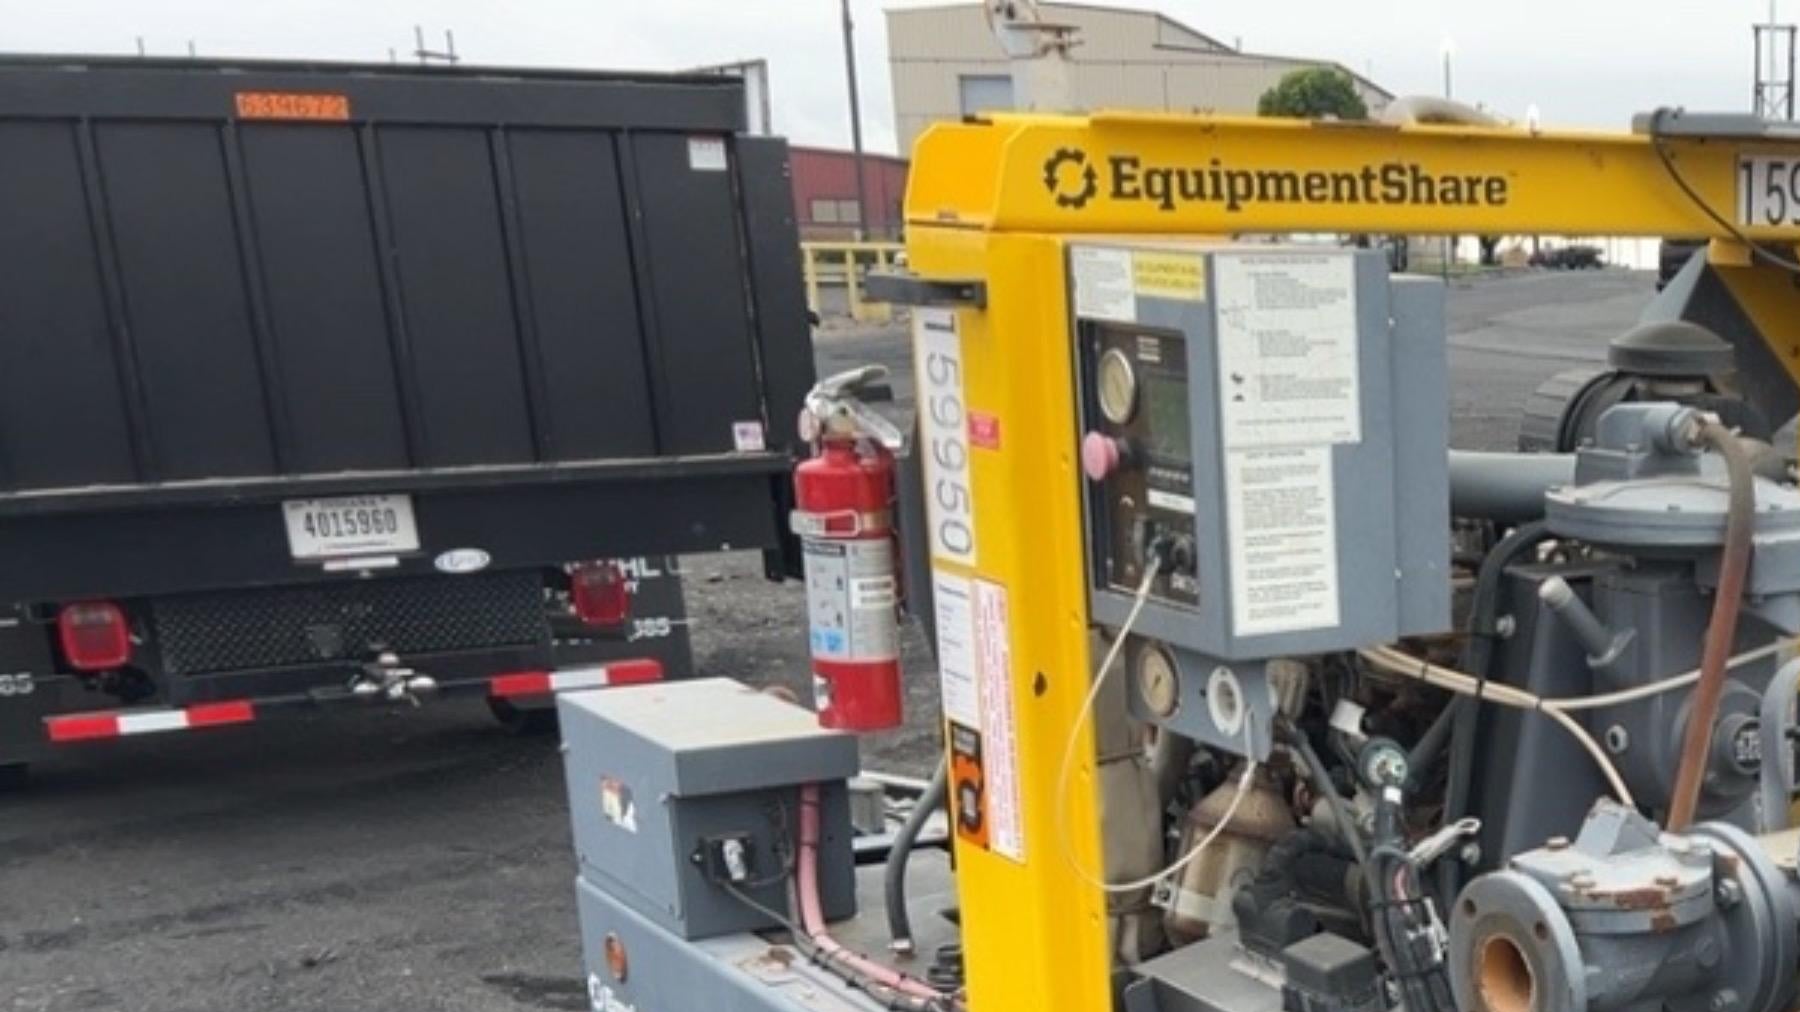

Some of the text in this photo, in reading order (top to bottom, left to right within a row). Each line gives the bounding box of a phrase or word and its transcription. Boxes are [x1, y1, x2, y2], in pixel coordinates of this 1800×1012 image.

[1110, 156, 1508, 211] EquipmentShare
[924, 314, 973, 556] 159950
[304, 508, 398, 538] 4015960
